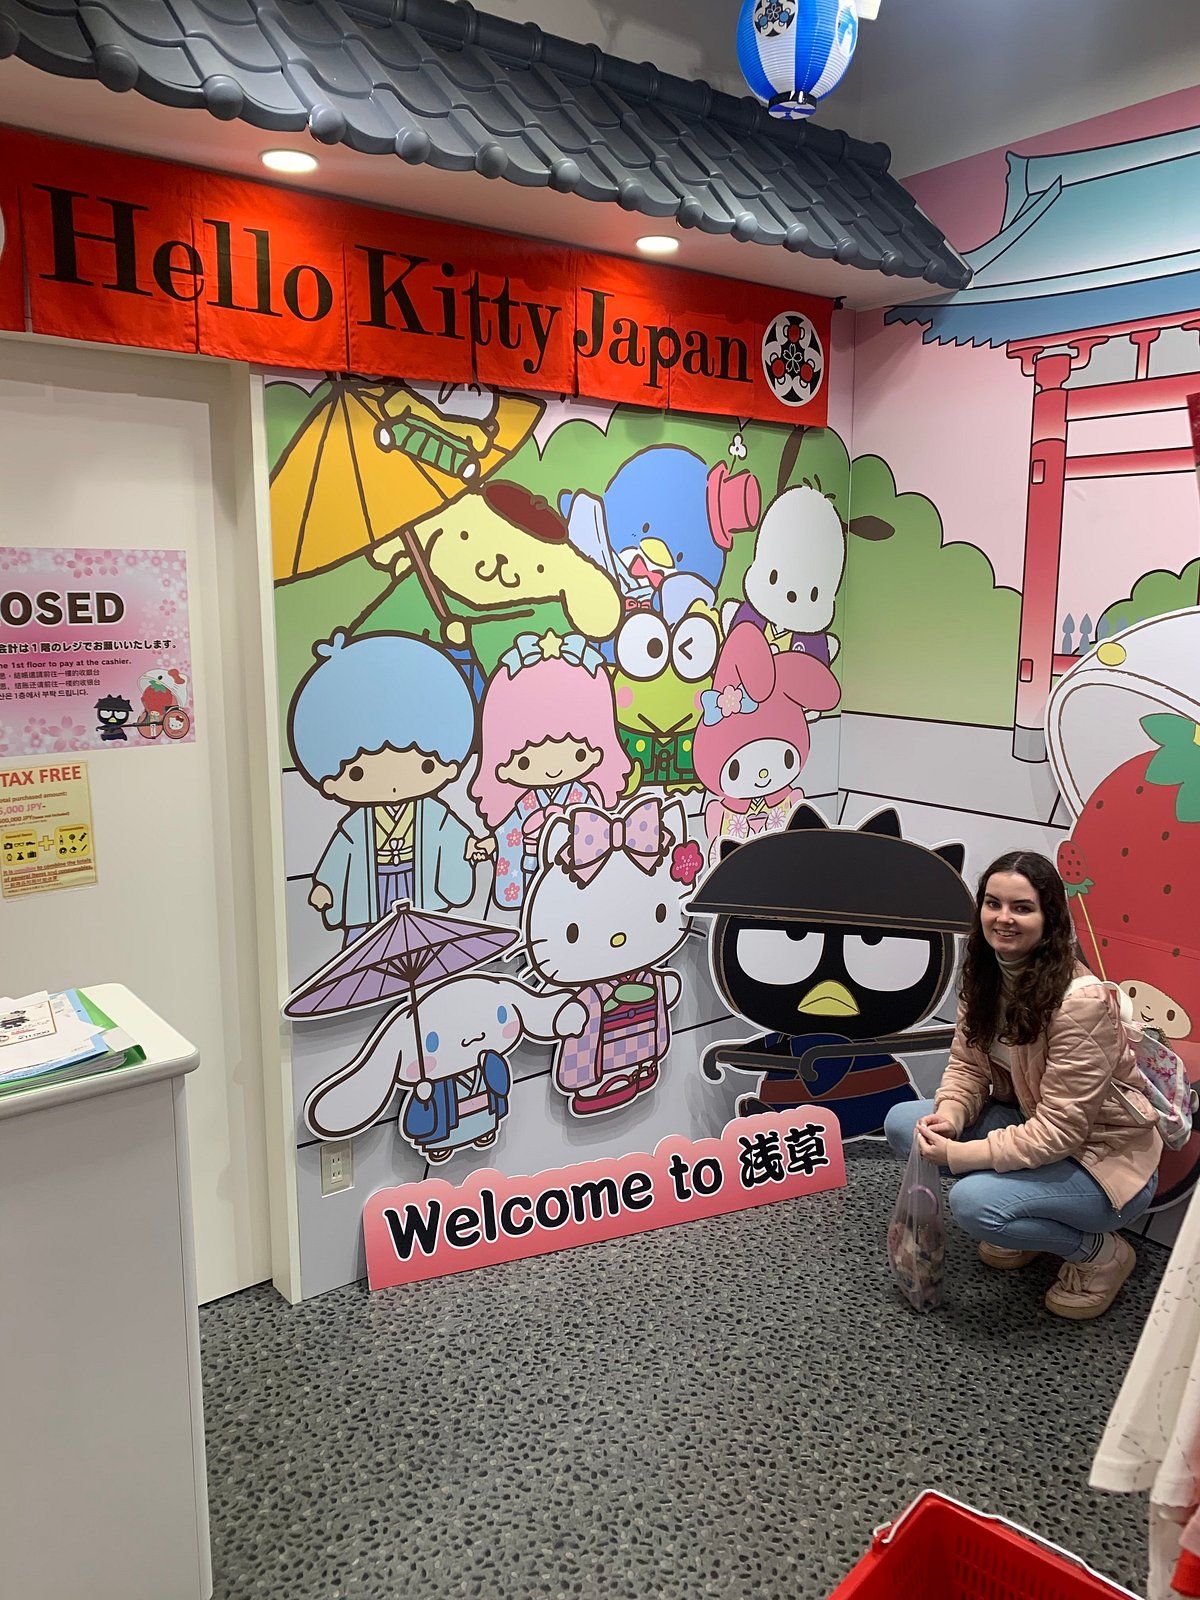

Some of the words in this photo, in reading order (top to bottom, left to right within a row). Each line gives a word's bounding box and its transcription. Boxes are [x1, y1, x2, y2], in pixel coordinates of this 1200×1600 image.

[33, 183, 333, 321] Hello
[355, 244, 562, 374] Kitty
[574, 286, 754, 389] Japan
[0, 591, 124, 626] OSED
[0, 770, 34, 788] TAX
[39, 765, 82, 783] FREE
[383, 1171, 653, 1259] Welcome
[668, 1154, 724, 1201] to
[739, 1123, 830, 1188] 浅草
